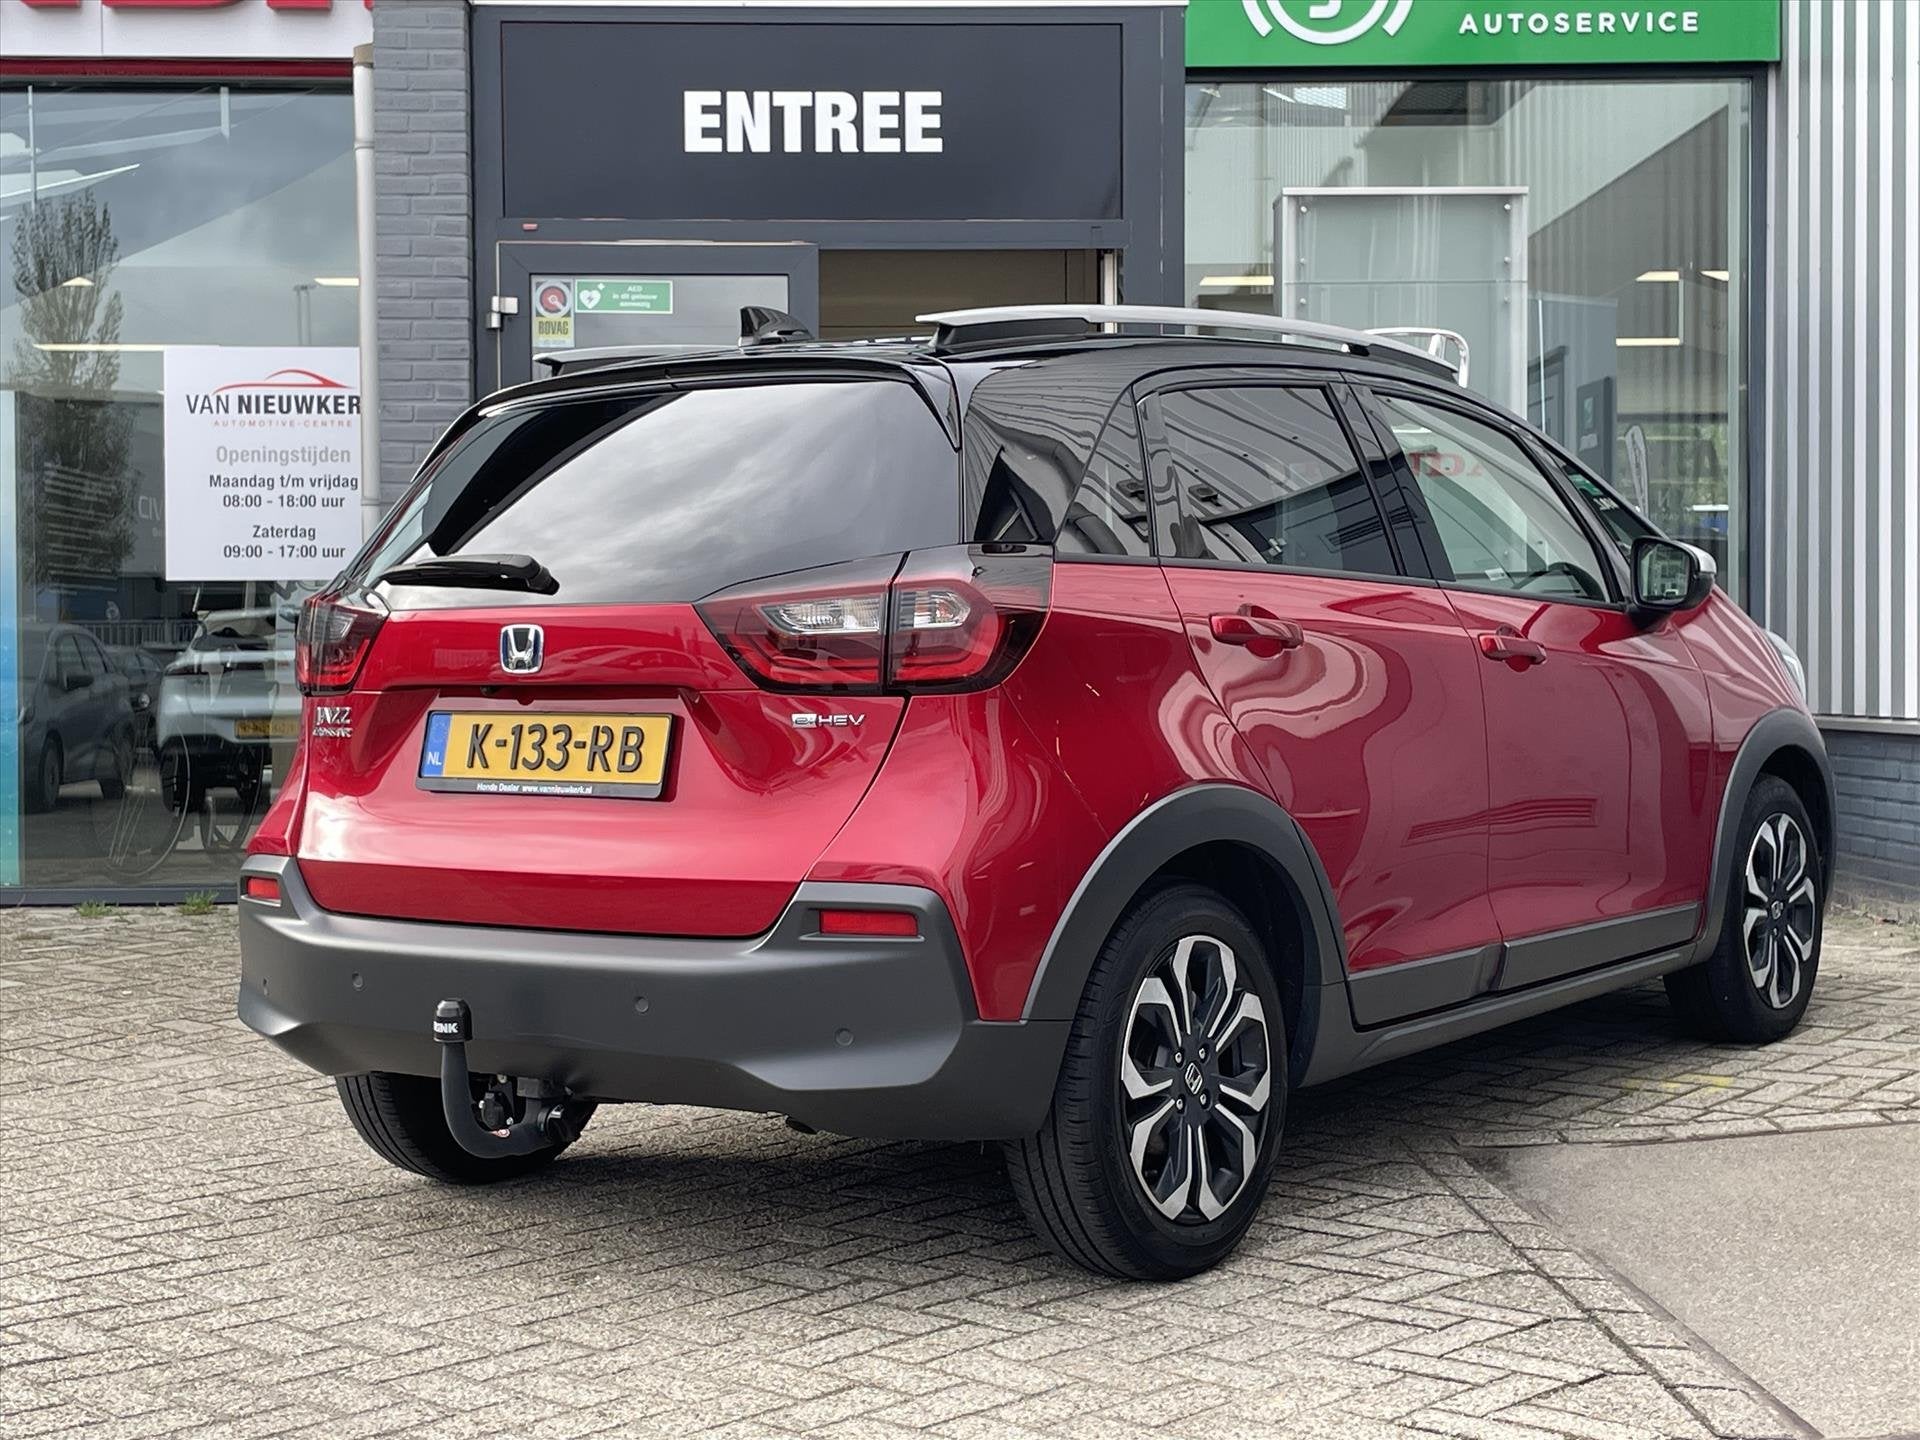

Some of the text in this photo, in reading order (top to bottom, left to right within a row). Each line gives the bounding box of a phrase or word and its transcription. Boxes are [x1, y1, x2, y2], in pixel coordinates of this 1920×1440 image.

[1459, 12, 1700, 34] AUTOSERVICE
[683, 90, 944, 153] ENTREE
[538, 321, 569, 335] BOVAG
[186, 395, 229, 414] VAN
[213, 420, 353, 428] AUTOMOTIVE-CENTRE
[216, 446, 351, 466] Openingstijden
[209, 474, 359, 490] Maandag t/m vrijdag
[223, 494, 262, 508] 08:00
[279, 494, 317, 508] 18:00
[321, 497, 346, 508] uur
[252, 525, 316, 541] Zaterdag
[223, 544, 262, 558] 09:00
[279, 544, 317, 558] 17:00
[322, 547, 346, 558] uur
[466, 723, 645, 773] K-133-RB
[427, 752, 442, 766] NL
